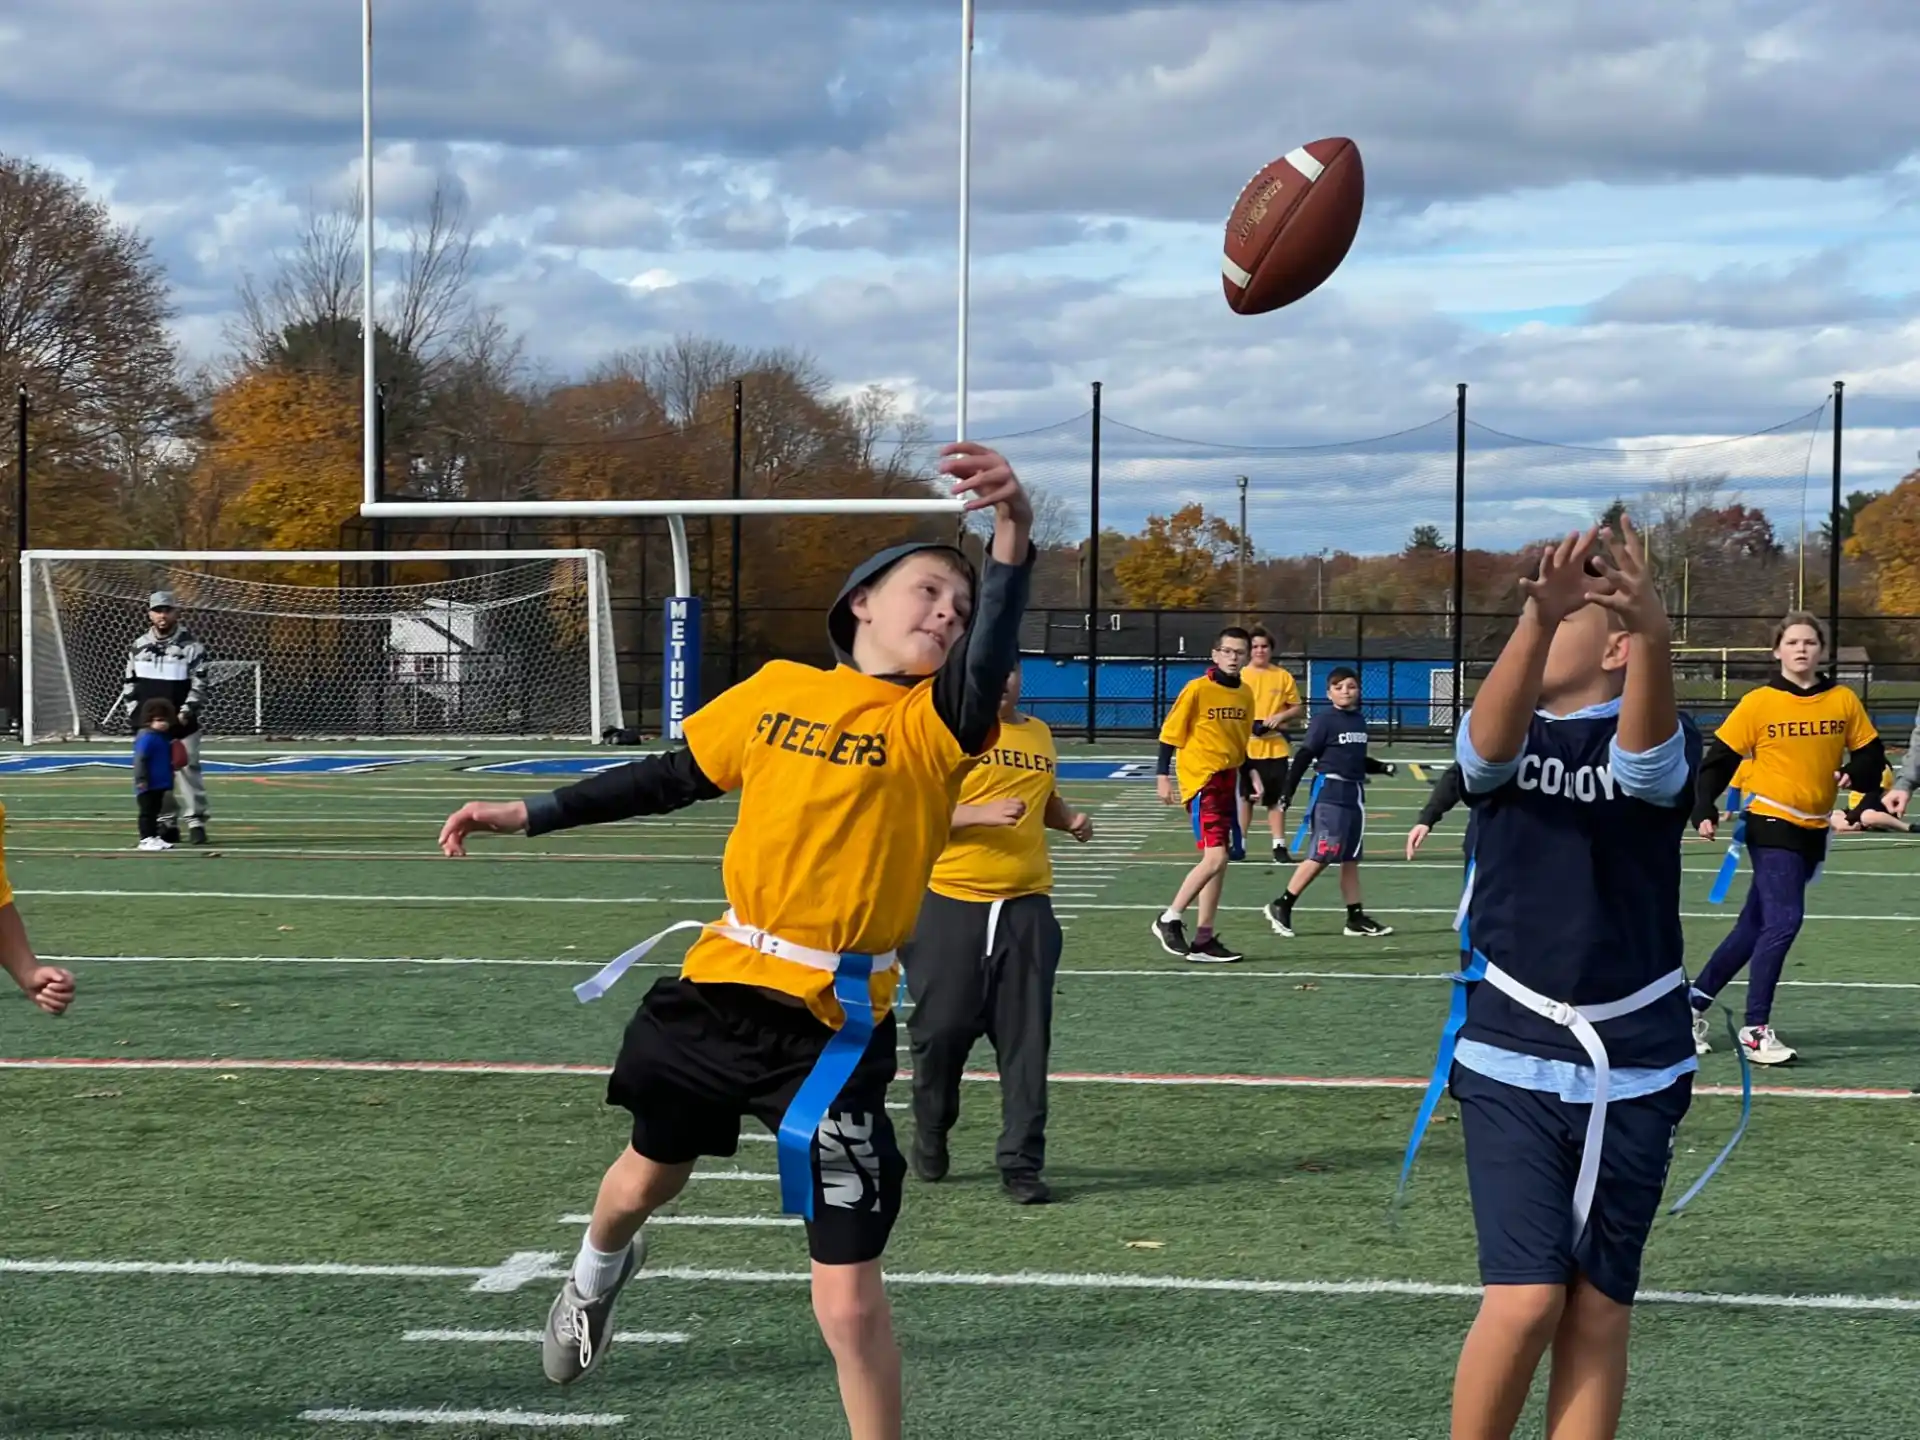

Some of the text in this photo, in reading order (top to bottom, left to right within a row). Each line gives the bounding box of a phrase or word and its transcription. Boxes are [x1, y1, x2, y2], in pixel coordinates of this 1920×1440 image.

[670, 601, 687, 739] METHUEN
[1767, 720, 1845, 738] STEELERS
[818, 1108, 881, 1212] NIKE
